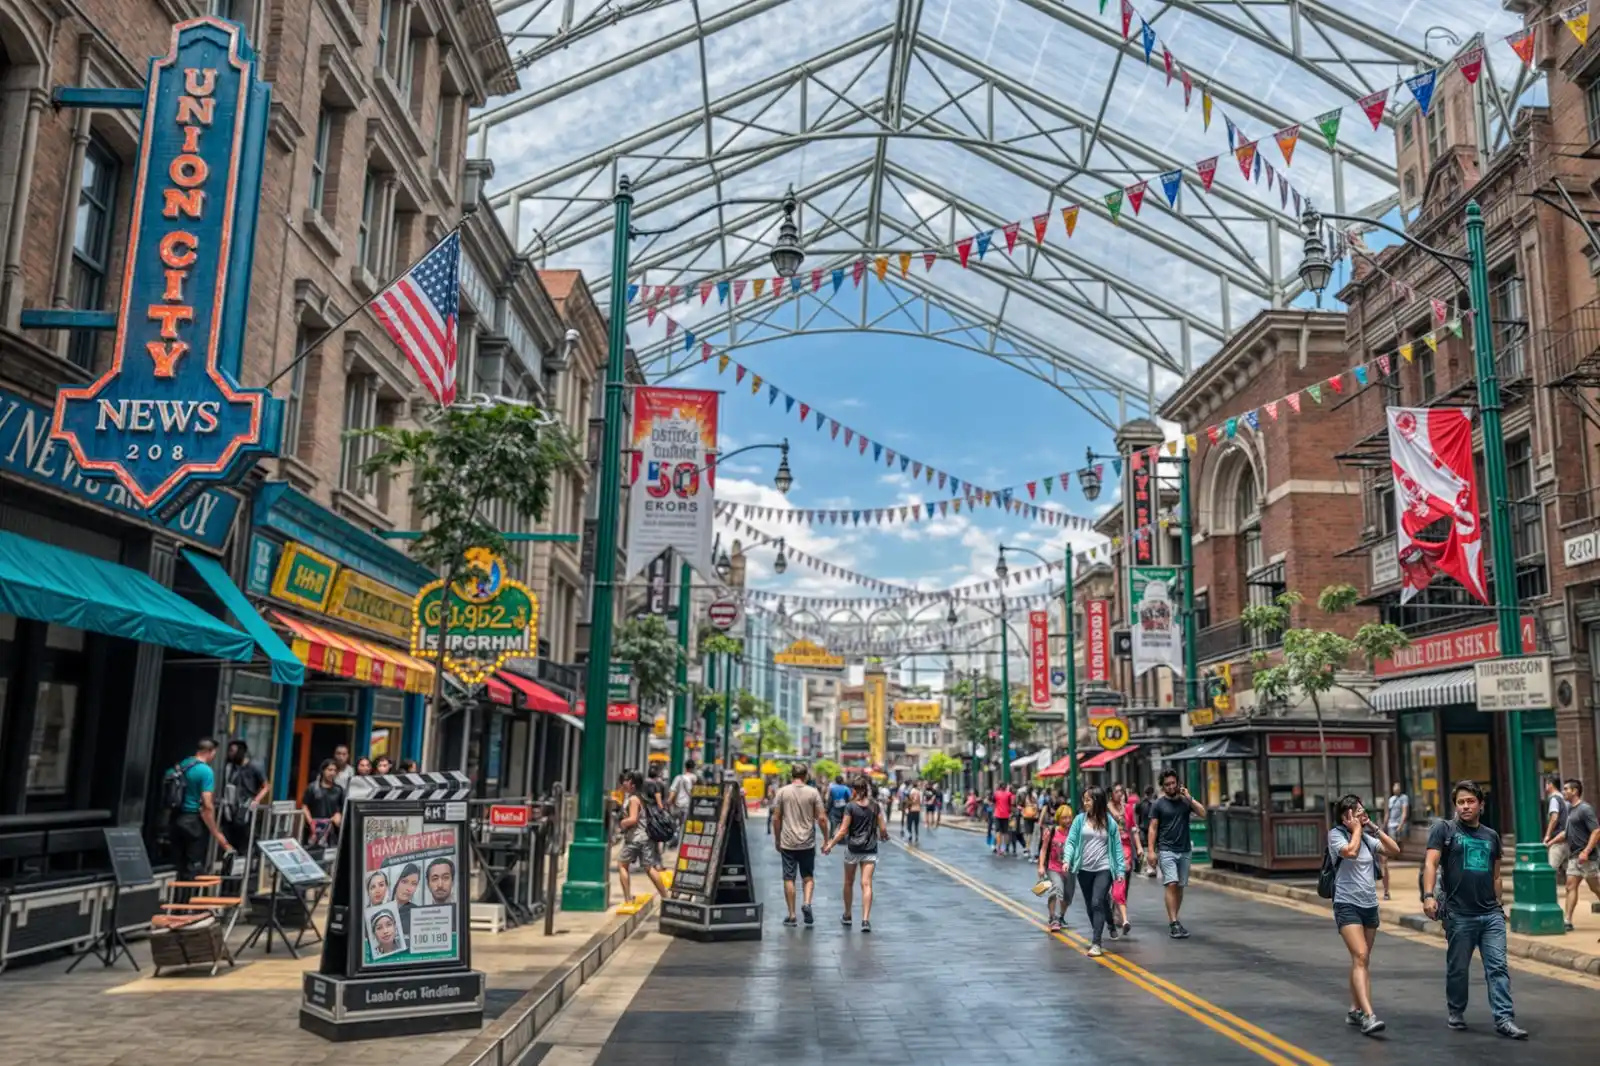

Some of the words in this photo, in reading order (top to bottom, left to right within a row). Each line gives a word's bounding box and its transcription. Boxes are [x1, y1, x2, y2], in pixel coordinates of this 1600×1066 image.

[163, 67, 218, 219] UNION
[146, 231, 198, 378] CITY
[95, 399, 221, 433] NEWS
[126, 444, 184, 460] 208
[646, 461, 700, 499] 50
[645, 501, 698, 512] EKORS
